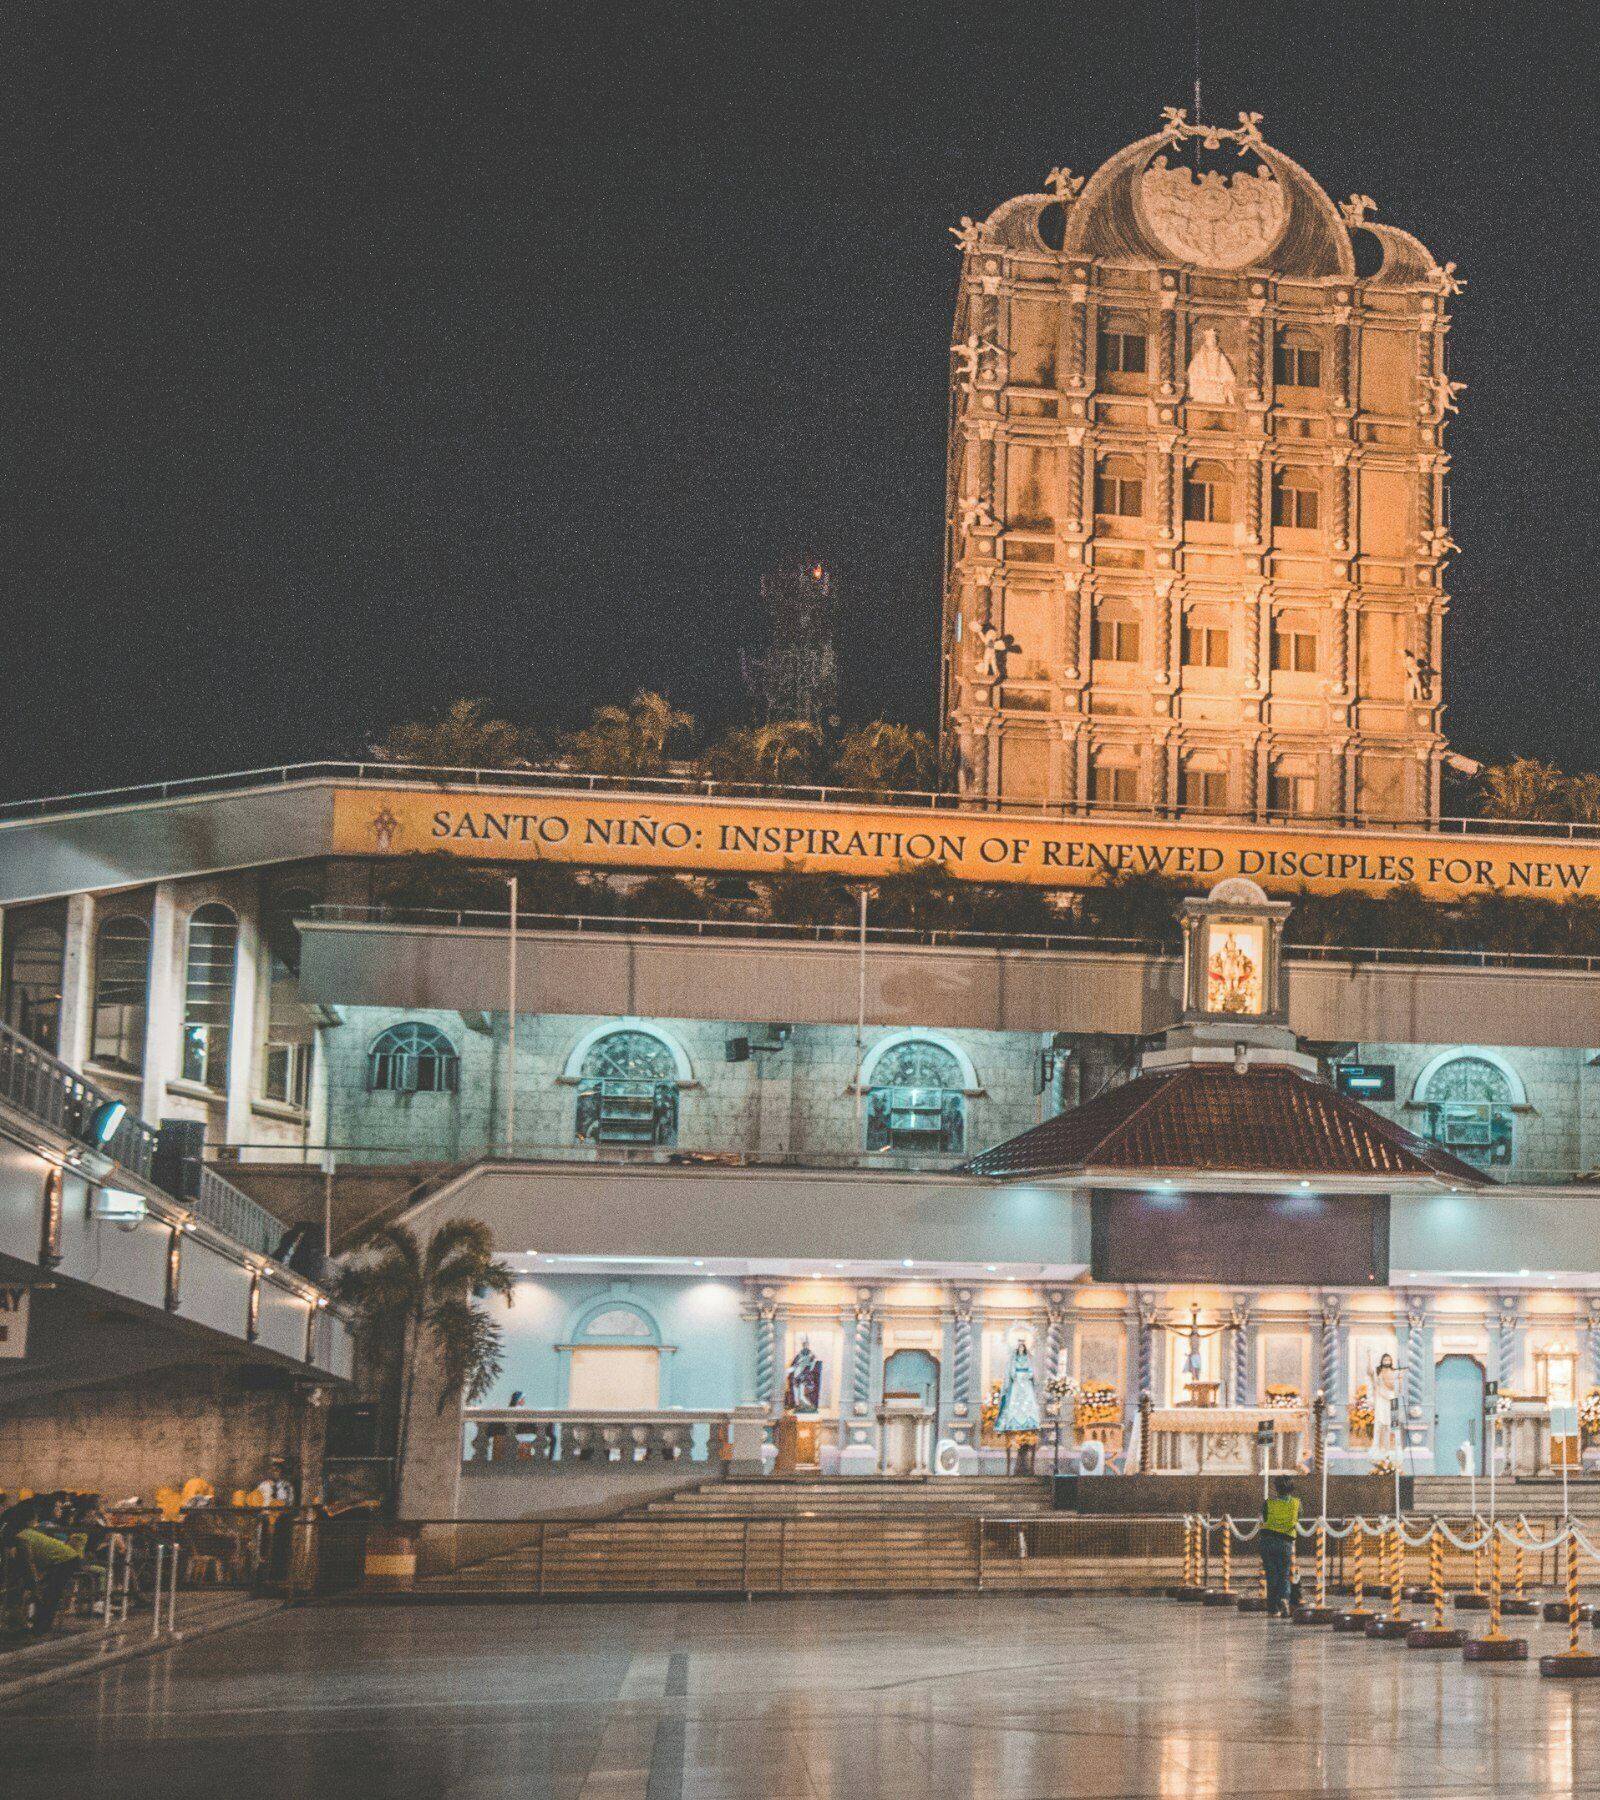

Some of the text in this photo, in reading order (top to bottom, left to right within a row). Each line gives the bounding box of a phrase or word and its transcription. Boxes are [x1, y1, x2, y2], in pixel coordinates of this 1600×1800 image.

[431, 810, 570, 842] SANTO
[583, 815, 702, 849] NIÑO:
[718, 825, 967, 861] INSPIRATION
[979, 838, 1030, 864] OF
[1042, 841, 1224, 872] RENEWED
[1238, 850, 1415, 881] DISCIPLES
[1427, 857, 1495, 885] FOR
[1506, 862, 1591, 888] NEW
